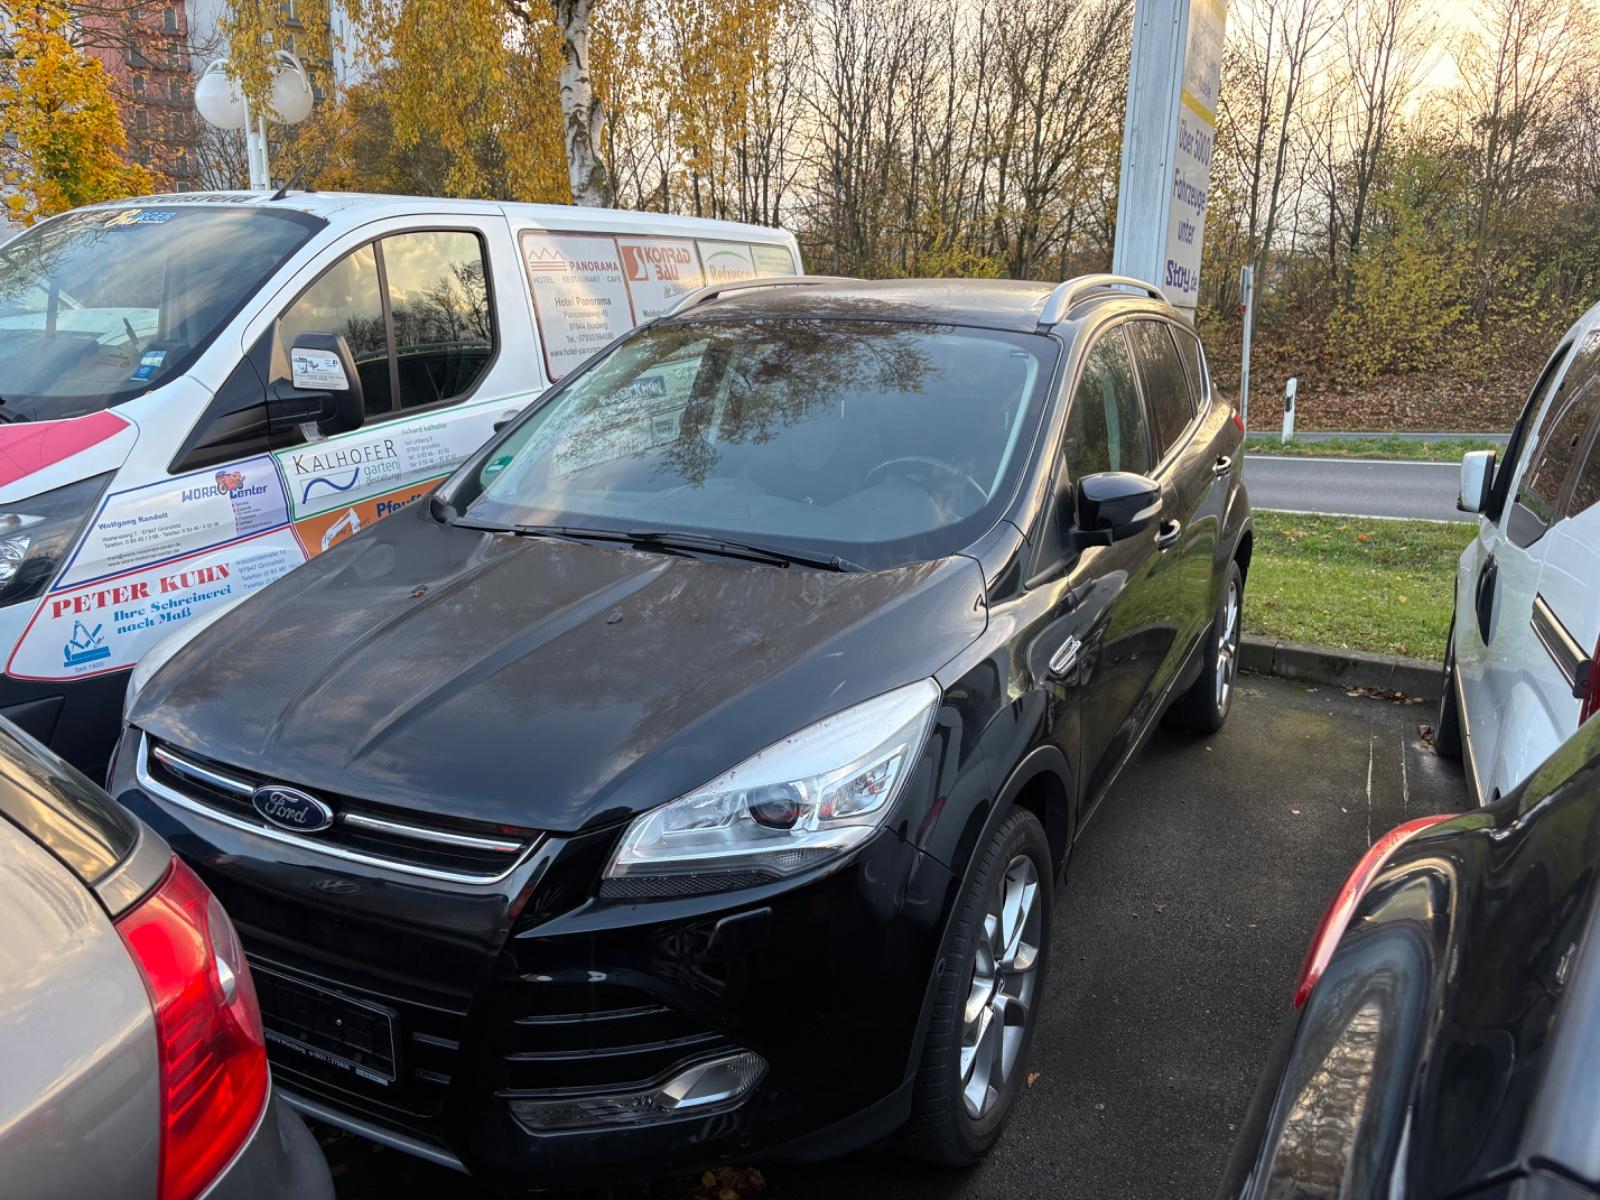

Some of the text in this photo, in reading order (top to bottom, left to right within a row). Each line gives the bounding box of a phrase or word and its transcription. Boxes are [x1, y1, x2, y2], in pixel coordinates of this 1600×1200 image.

[1173, 168, 1206, 217] Fahrzeuge
[1178, 218, 1195, 246] unter
[643, 246, 692, 265] KONRAD
[569, 260, 620, 272] PANORAMA
[655, 264, 680, 281] BAU
[533, 275, 554, 284] HOTEL
[554, 296, 612, 308] Hotel Panorama
[292, 439, 398, 475] KALHOFER
[363, 460, 400, 478] garten
[229, 485, 269, 500] Center
[98, 517, 138, 531] Wolfgang
[52, 563, 231, 620] PETER KUHN
[113, 585, 232, 623] Ihre Schreinerei
[117, 607, 192, 635] nach Maß
[264, 790, 309, 824] Ford
